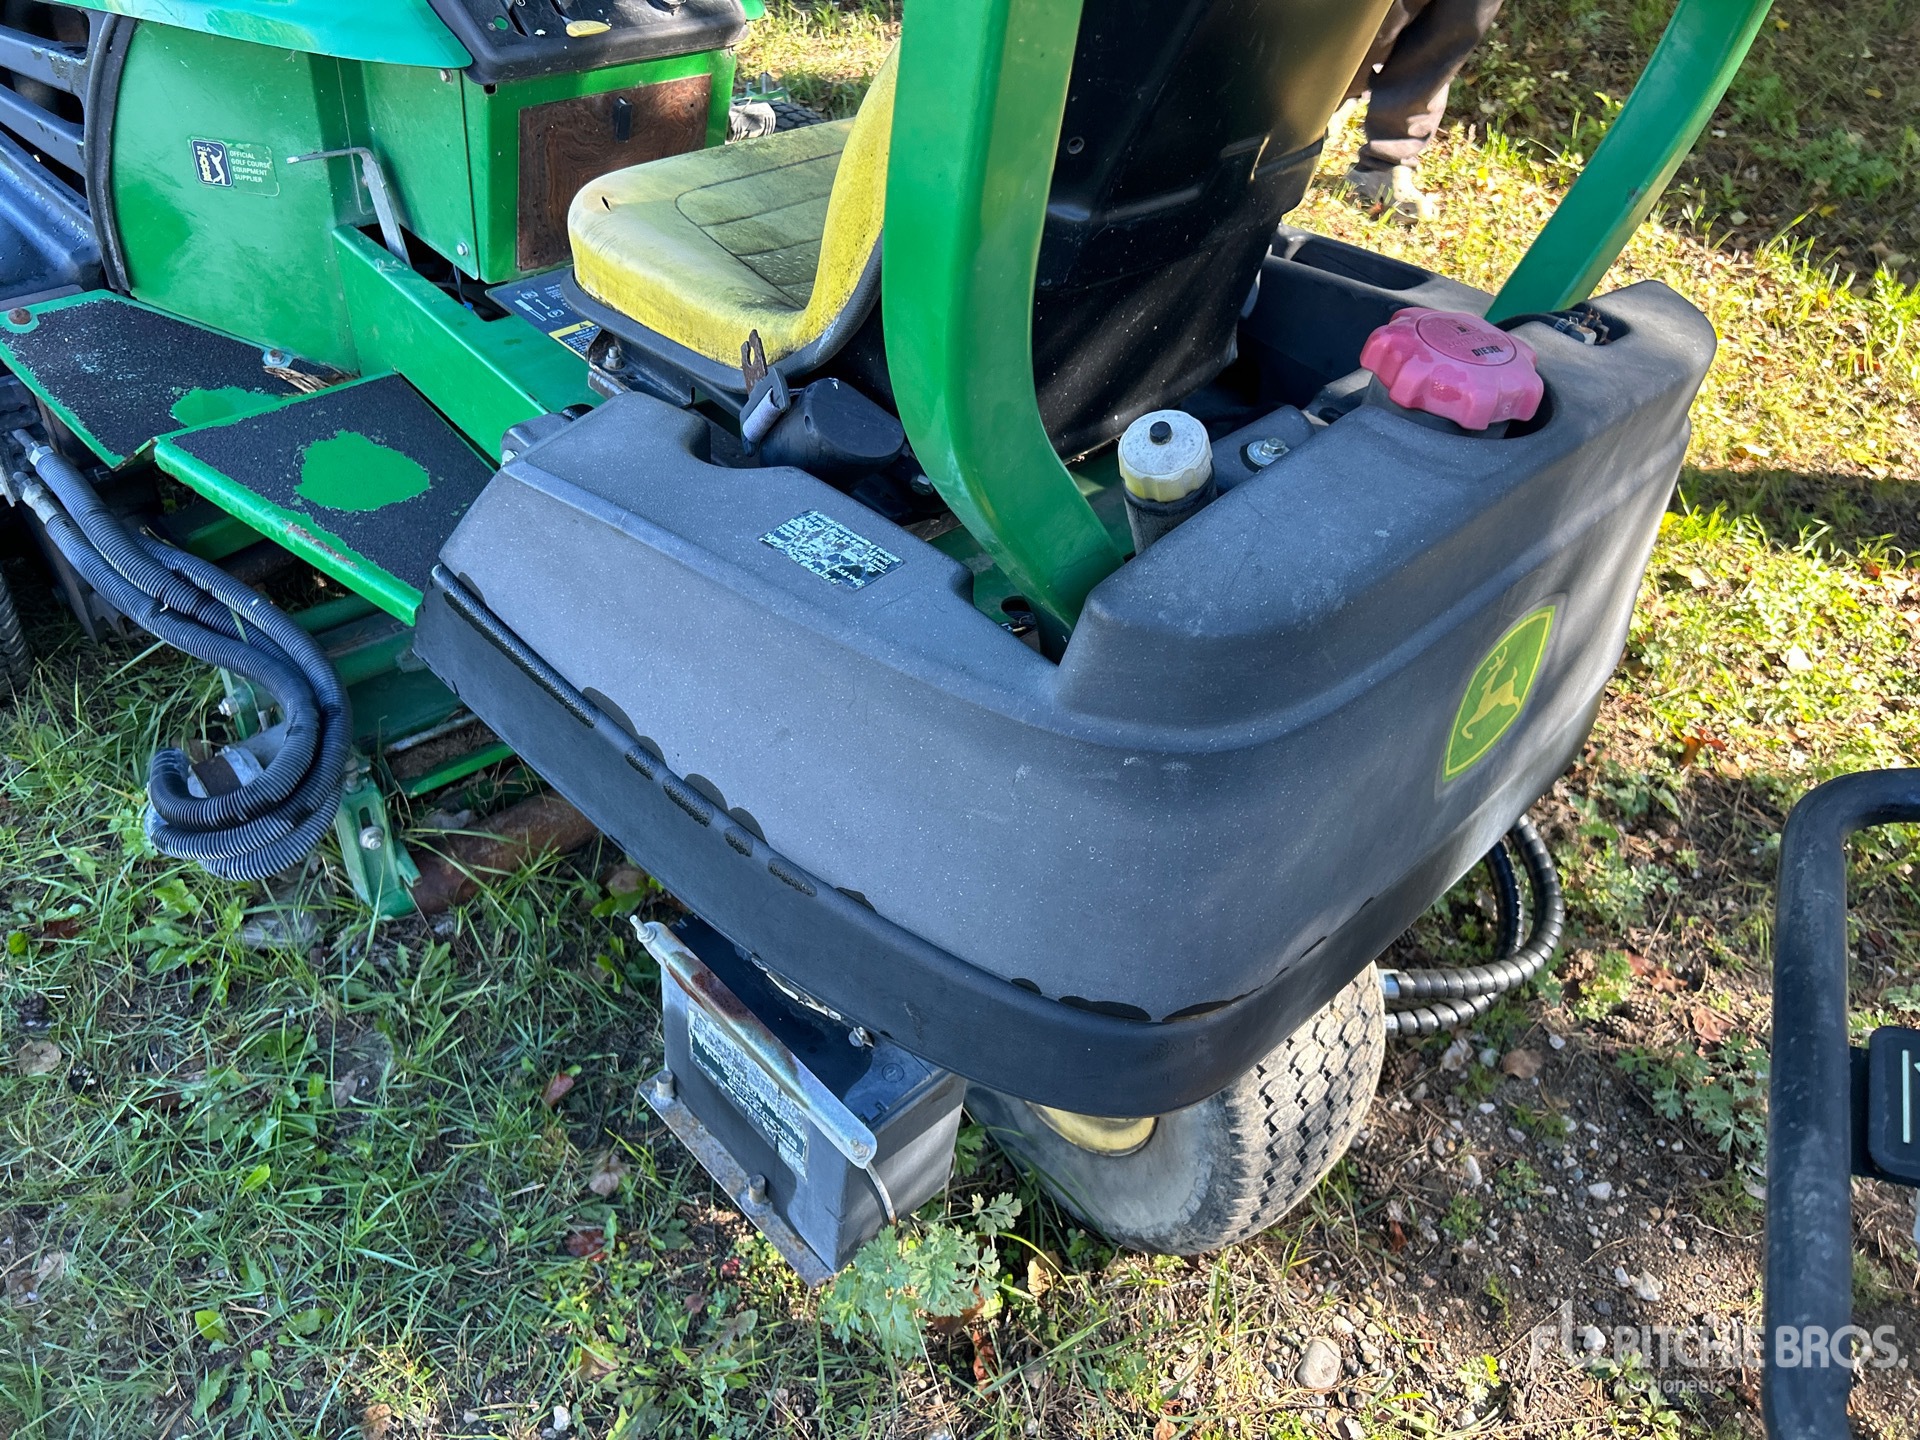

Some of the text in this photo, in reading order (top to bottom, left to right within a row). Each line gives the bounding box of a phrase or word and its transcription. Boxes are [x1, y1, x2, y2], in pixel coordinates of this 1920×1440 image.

[196, 145, 212, 153] PGA
[229, 150, 255, 159] OFFICIAL
[230, 158, 271, 169] GOLF COURSE
[232, 165, 268, 176] EQUIPMENT
[234, 174, 262, 183] SUPPLIER
[1471, 345, 1503, 356] DIESEL
